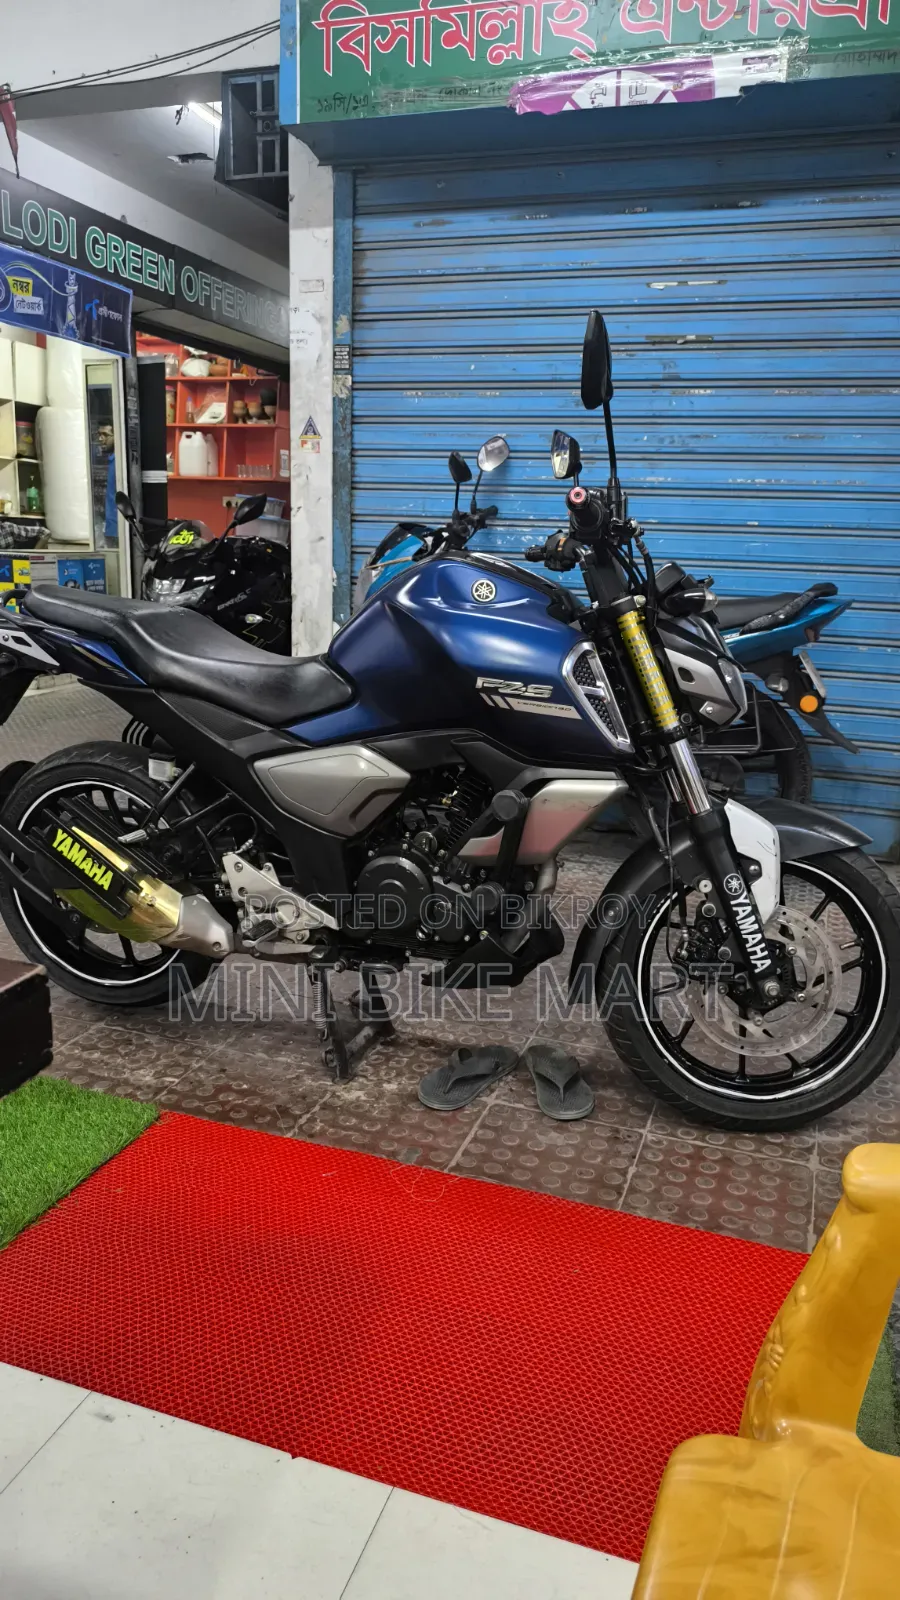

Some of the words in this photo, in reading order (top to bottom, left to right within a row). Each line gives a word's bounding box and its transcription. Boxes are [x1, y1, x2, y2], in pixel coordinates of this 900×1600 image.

[0, 189, 78, 260] LODI
[85, 225, 176, 296] GREEN
[12, 278, 31, 294] নম্বর
[52, 828, 114, 891] YAMAHA
[730, 890, 772, 973] YAMAHA
